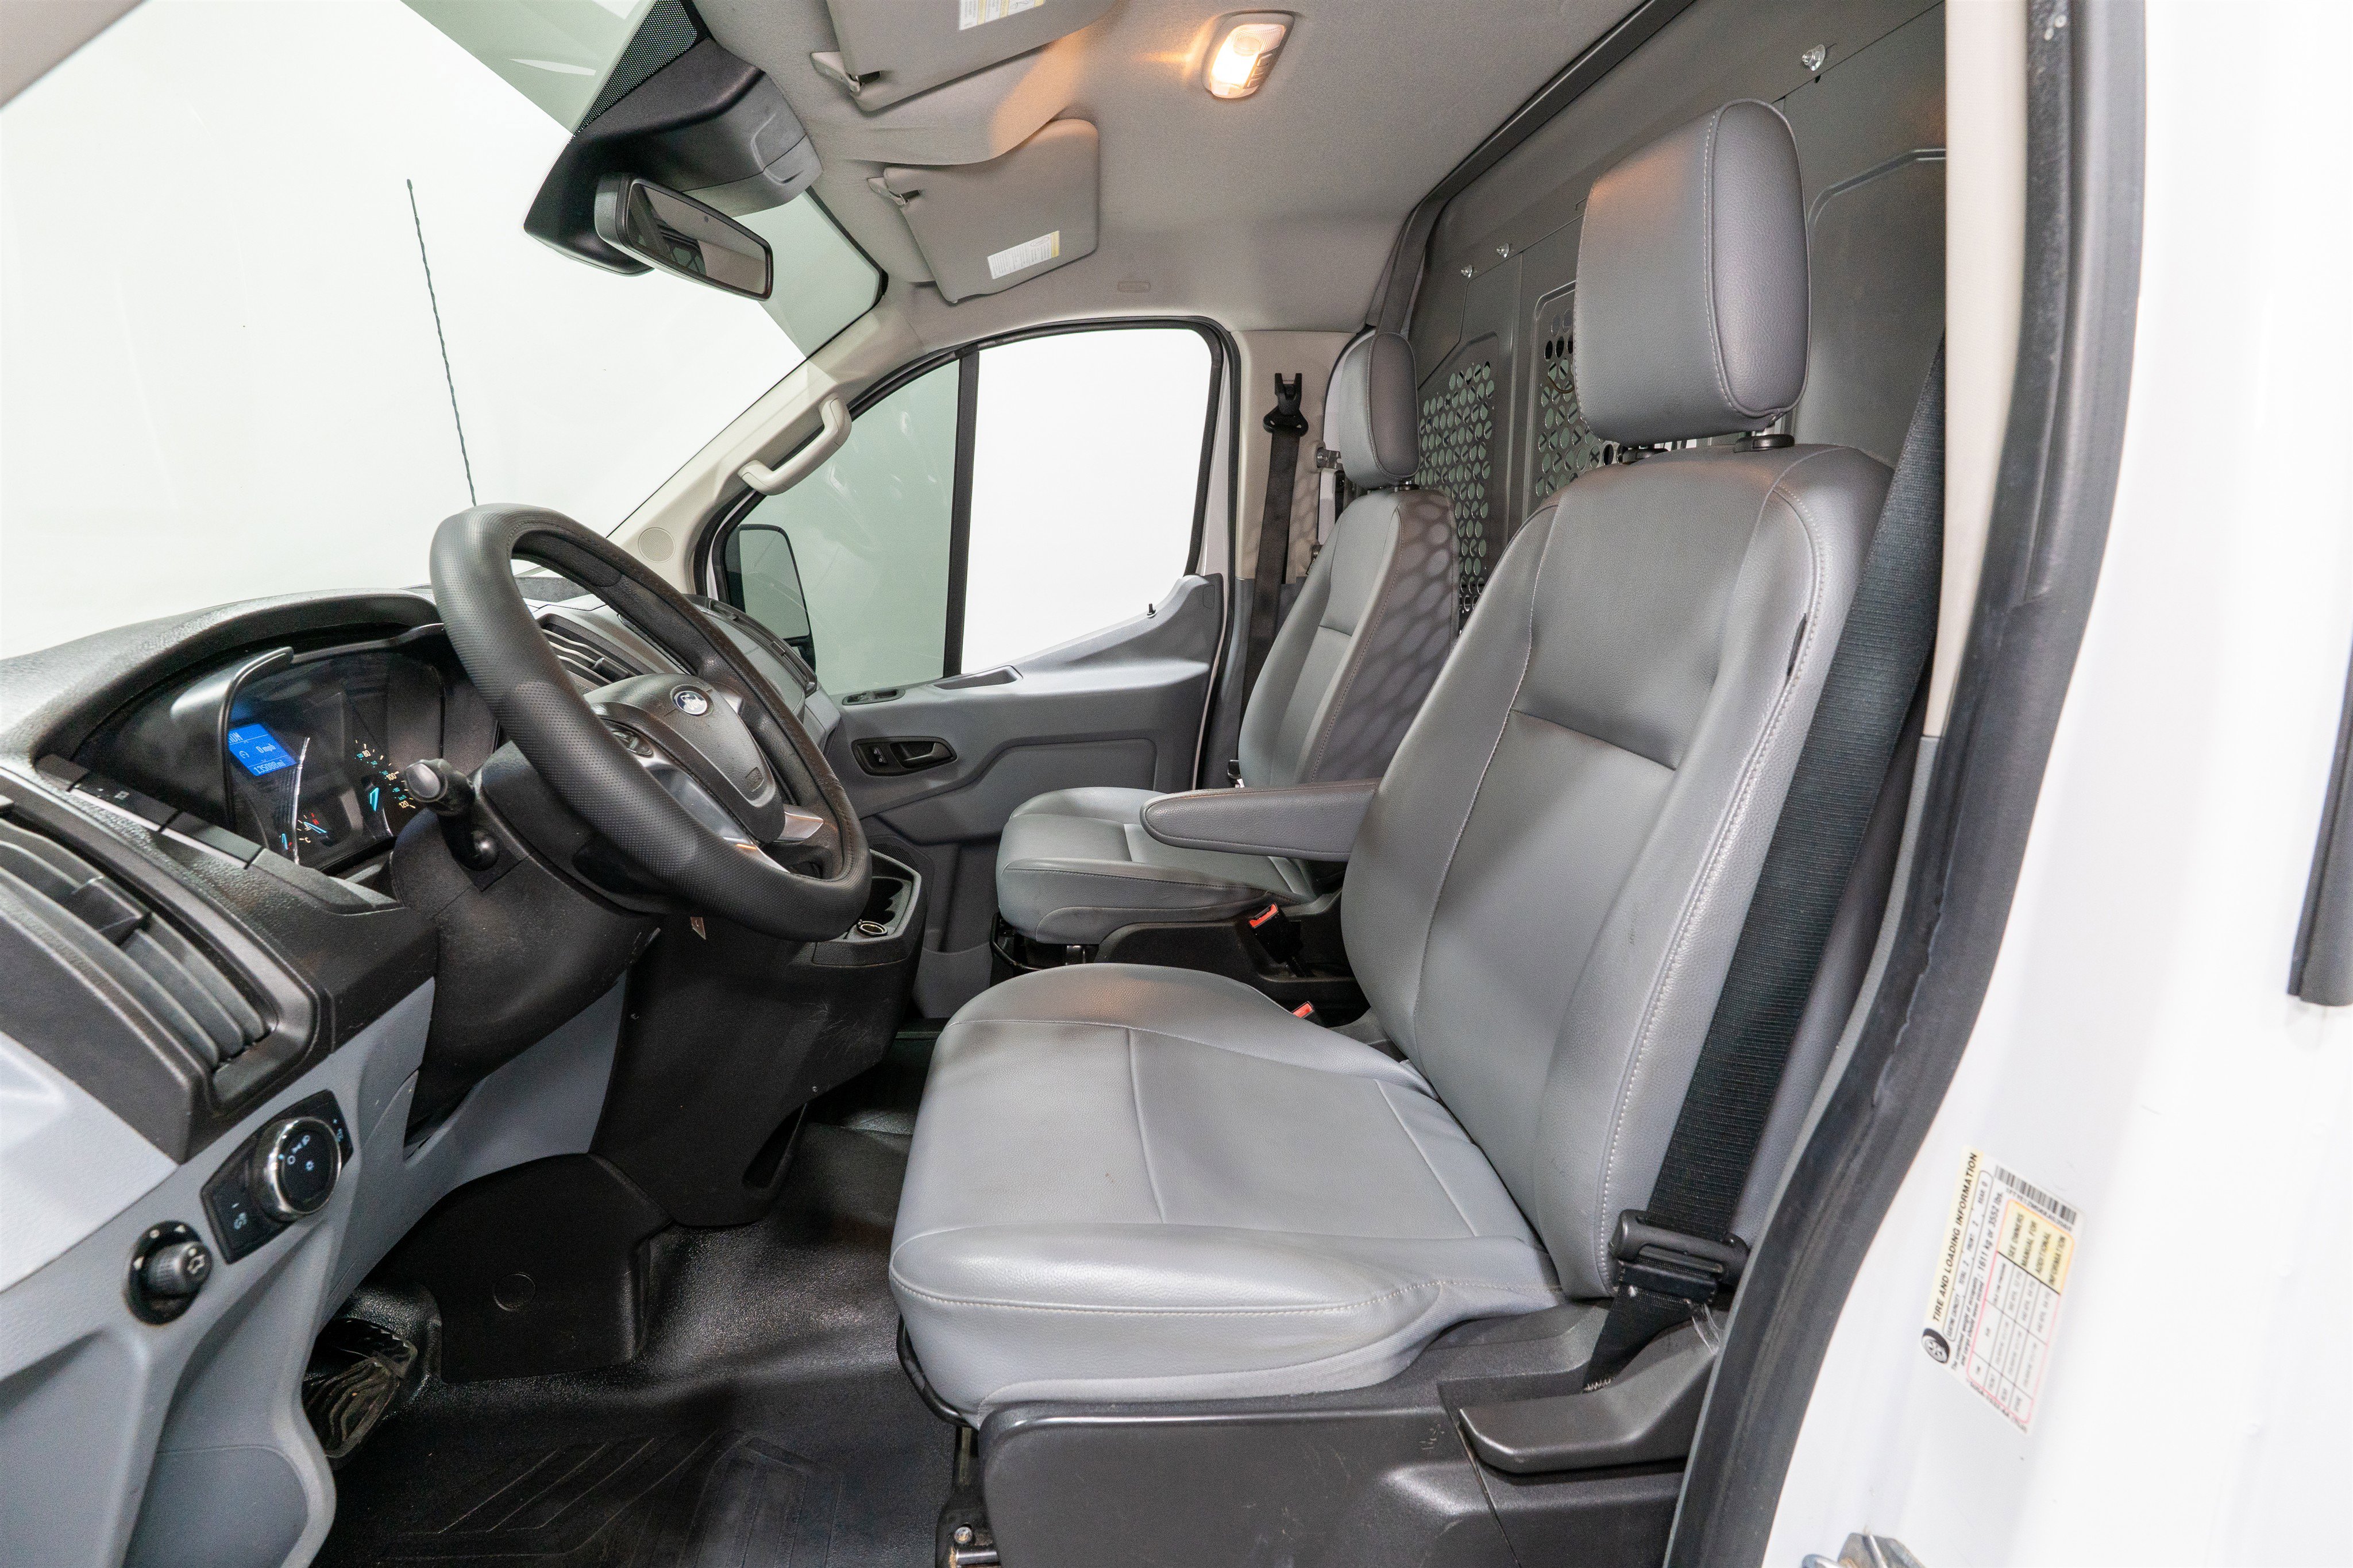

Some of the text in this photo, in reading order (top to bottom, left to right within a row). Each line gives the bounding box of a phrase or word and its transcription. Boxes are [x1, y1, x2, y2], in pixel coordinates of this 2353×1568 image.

[362, 750, 371, 758] 80
[386, 773, 397, 781] 100
[399, 800, 409, 809] 120
[1988, 1205, 1999, 1227] 3552
[1932, 1153, 1977, 1322] TIRE AND LOADING INFORMATION
[1987, 1229, 1993, 1238] or
[2008, 1245, 2016, 1258] SEE
[2012, 1214, 2023, 1243] OWNERS
[1983, 1239, 1993, 1250] kg
[2021, 1239, 2034, 1268] MANUAL
[2035, 1233, 2051, 1274] ADDITIONAL
[1977, 1251, 1988, 1271] 1611
[2049, 1236, 2066, 1285] INFORMATION
